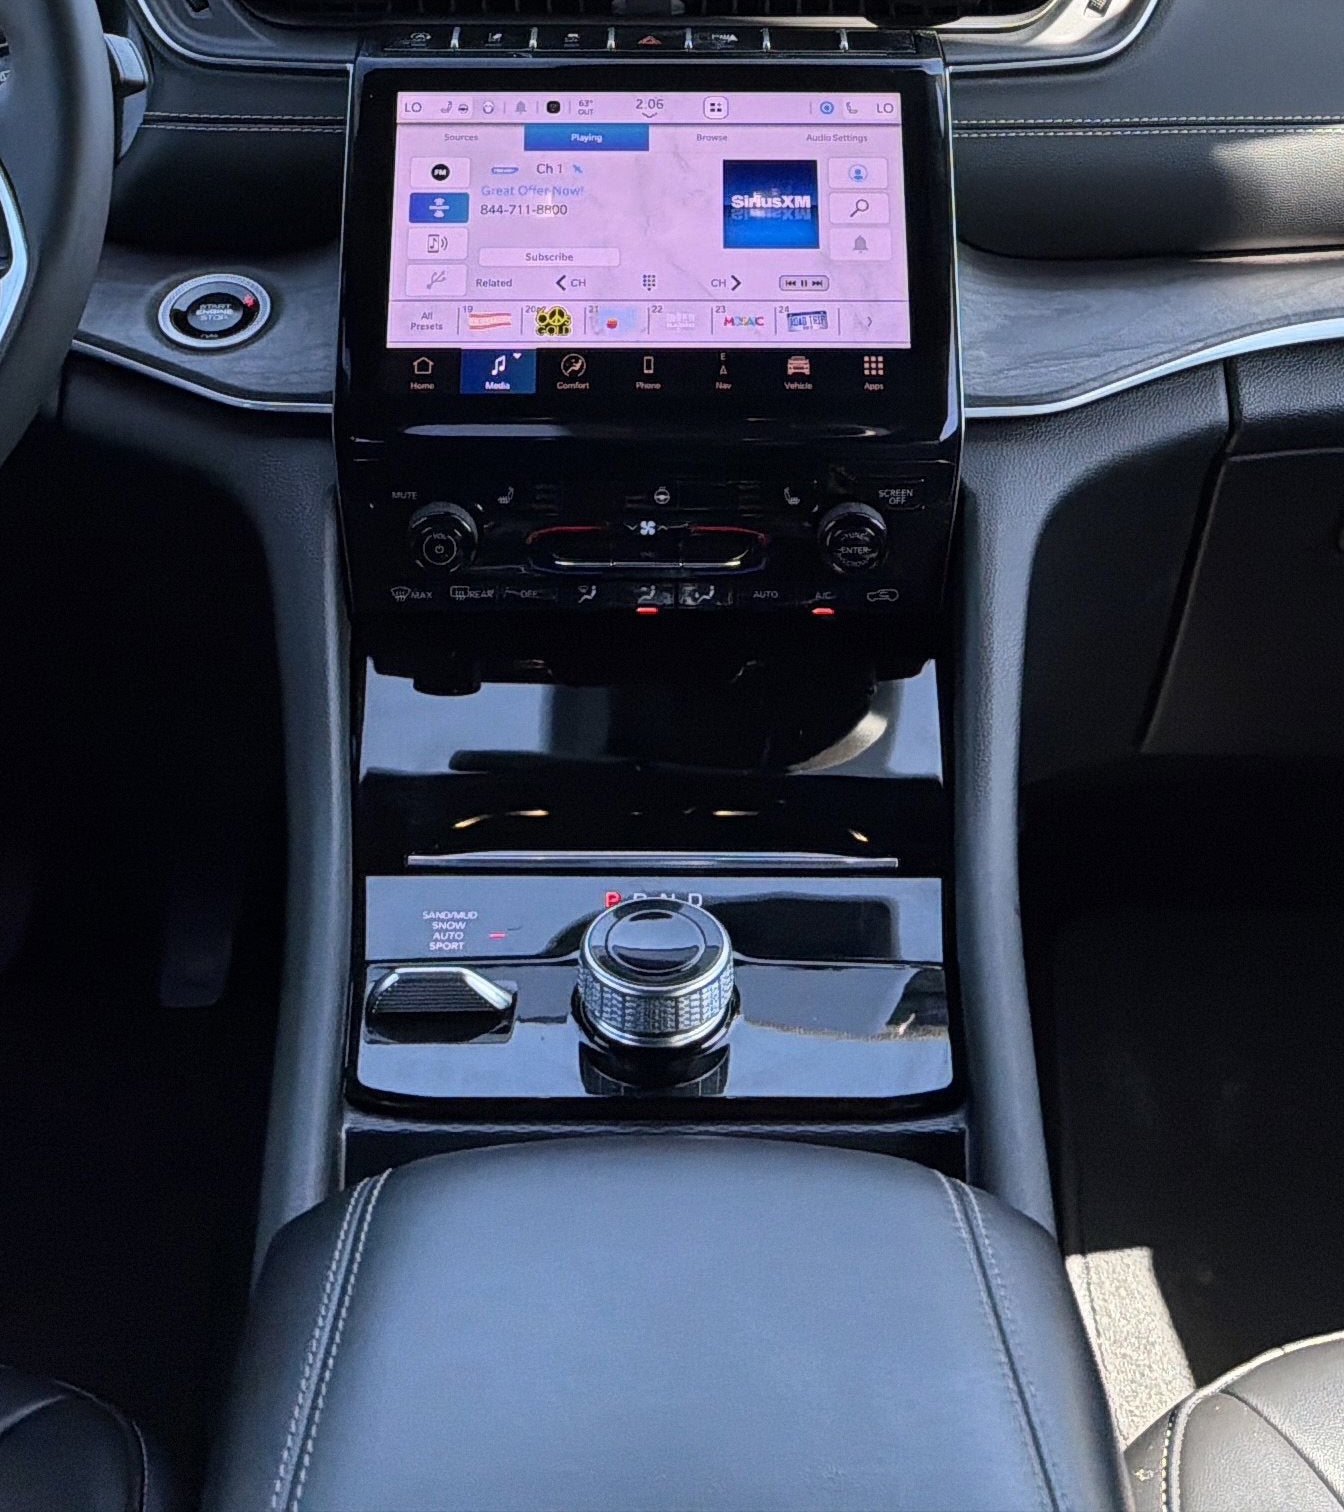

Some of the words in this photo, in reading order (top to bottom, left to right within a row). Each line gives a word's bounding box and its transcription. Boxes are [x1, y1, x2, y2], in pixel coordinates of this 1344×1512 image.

[404, 102, 422, 114] LO
[578, 108, 594, 116] OUT
[876, 103, 895, 114] LO
[444, 133, 478, 142] Sources
[570, 133, 603, 144] Playing
[696, 134, 728, 142] Browse
[806, 134, 832, 142] Audio
[833, 134, 868, 145] Settings
[434, 168, 448, 177] FM
[536, 163, 555, 175] Ch
[480, 186, 520, 196] Great
[522, 185, 549, 196] Offer
[552, 186, 584, 196] Now!
[730, 193, 812, 210] SiriusXM
[480, 204, 568, 216] 844-711-8800
[525, 252, 574, 262] Subscribe
[476, 278, 513, 288] Related
[570, 278, 586, 288] CH
[710, 278, 727, 288] CH
[462, 305, 474, 313] 19
[652, 305, 663, 314] 22
[716, 305, 726, 314] 23
[778, 306, 790, 314] 24
[420, 311, 433, 320] All
[410, 321, 444, 331] Presets
[536, 325, 572, 337] GOLD
[410, 381, 435, 390] Home
[484, 381, 511, 390] Media
[556, 381, 590, 390] Comfort
[635, 381, 662, 390] Phone
[716, 381, 732, 390] Nav
[784, 381, 813, 390] Vehicle
[864, 381, 884, 392] Apps
[391, 491, 418, 500] MUTE
[878, 489, 914, 498] SCREEN
[888, 496, 906, 506] OFF
[841, 546, 869, 554] ENTER
[411, 590, 433, 600] MAX
[752, 590, 779, 600] AUTO
[604, 892, 622, 908] P
[688, 893, 704, 908] D
[422, 910, 478, 920] SAND/MUD
[432, 921, 466, 930] SNOW
[432, 932, 464, 940] AUTO
[429, 942, 464, 951] SPORT
